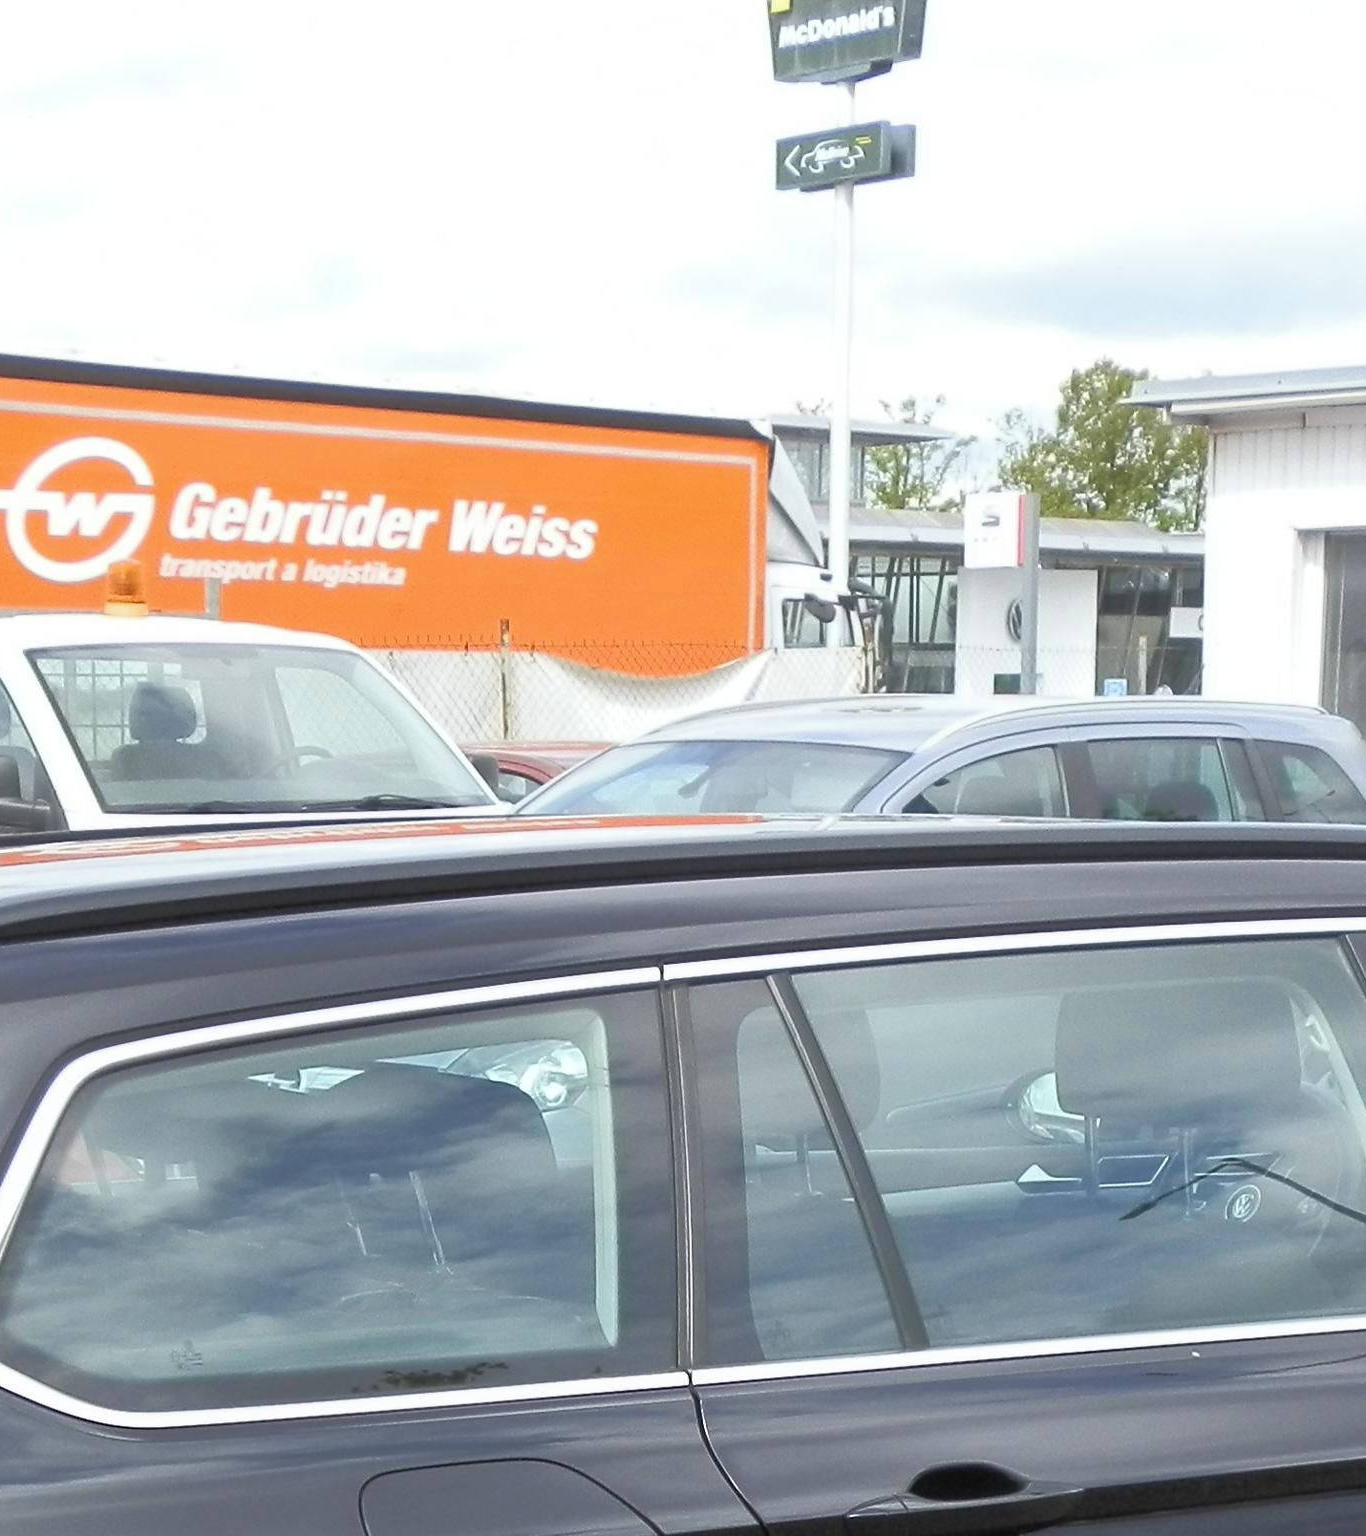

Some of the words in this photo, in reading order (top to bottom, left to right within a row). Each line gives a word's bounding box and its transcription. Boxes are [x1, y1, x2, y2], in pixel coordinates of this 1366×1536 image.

[778, 6, 895, 48] McDonald's
[169, 482, 439, 551] Gebrüder
[448, 499, 599, 560] Weiss
[159, 553, 278, 584] transport
[281, 562, 298, 582] a
[303, 558, 407, 588] logistika
